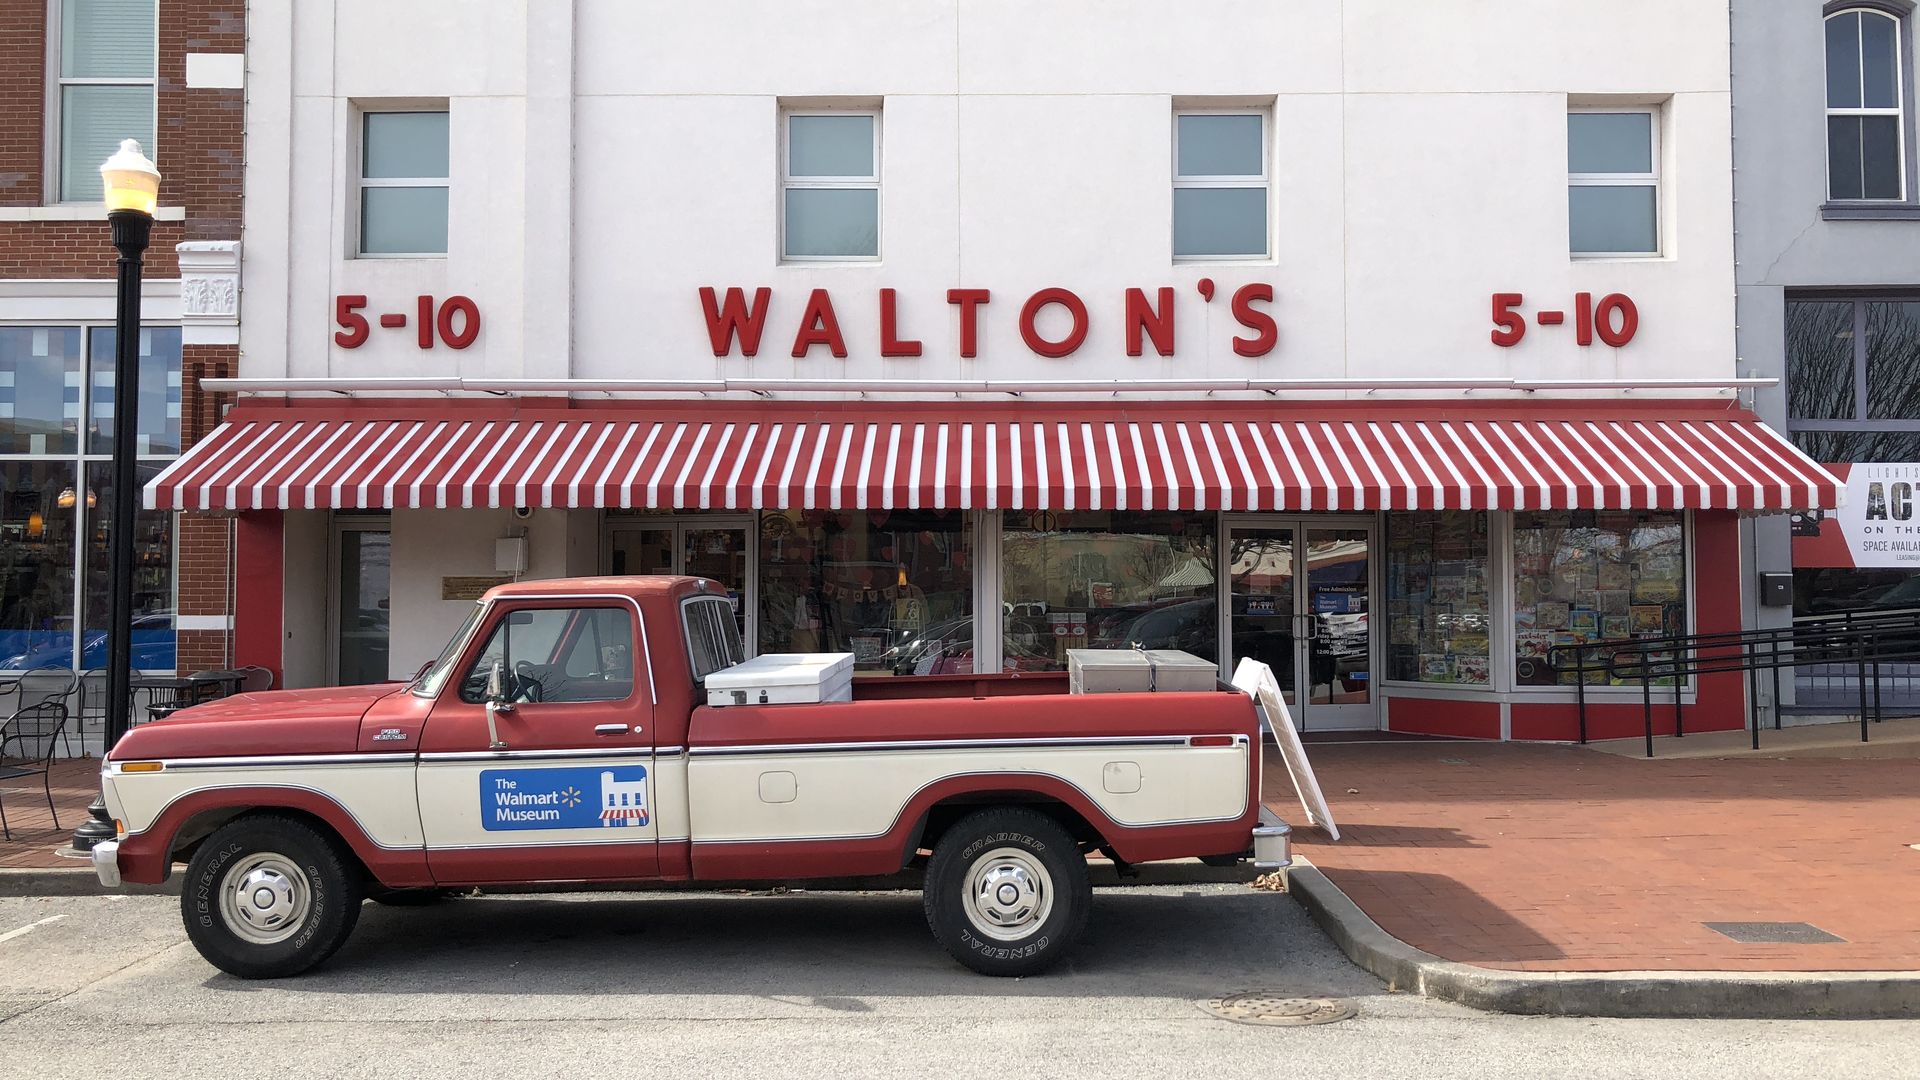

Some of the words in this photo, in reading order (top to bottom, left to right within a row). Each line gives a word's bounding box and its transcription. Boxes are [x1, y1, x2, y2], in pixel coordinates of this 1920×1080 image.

[335, 295, 481, 350] 5-10
[698, 278, 1279, 358] WALTON'S
[1491, 292, 1639, 347] 5-10
[1865, 482, 1920, 520] AC
[1864, 526, 1884, 534] ON
[1863, 540, 1888, 551] SPACE
[1891, 540, 1920, 551] AVAILA
[495, 778, 516, 789] The
[495, 791, 559, 806] Walmart
[496, 808, 560, 822] Museum
[962, 833, 1046, 860] GRABBER
[197, 843, 243, 927] GENERAL
[295, 865, 325, 949] GRABBER
[960, 929, 1050, 959] GENERAL
